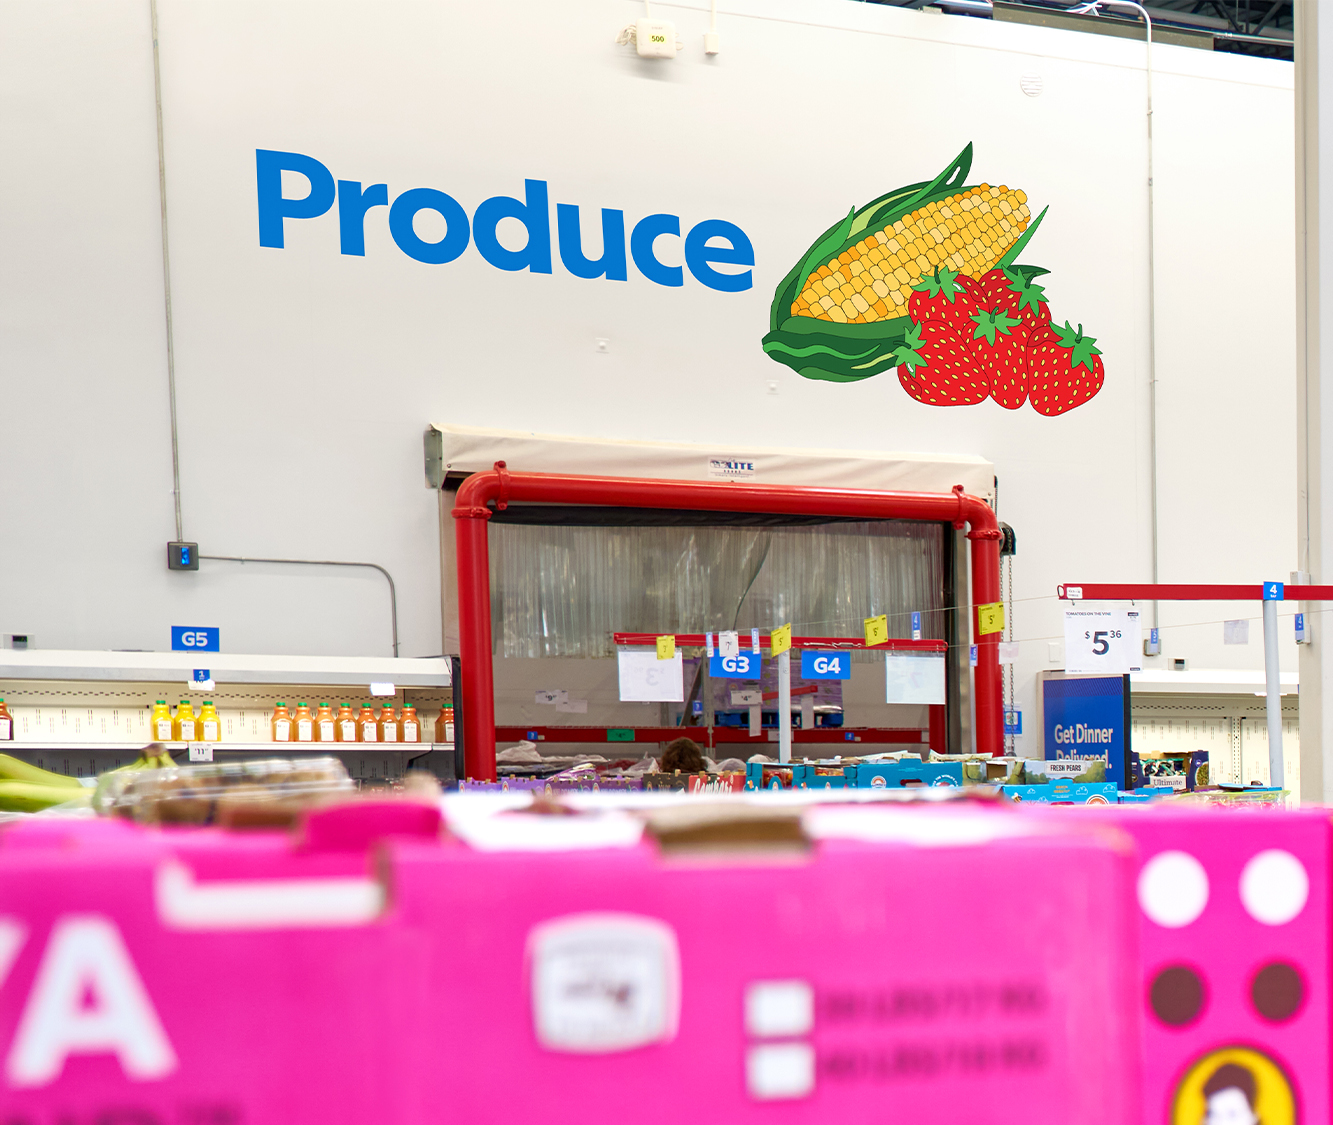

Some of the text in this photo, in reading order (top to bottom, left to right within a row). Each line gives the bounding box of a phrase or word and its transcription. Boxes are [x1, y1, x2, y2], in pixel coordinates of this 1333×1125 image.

[255, 148, 755, 293] Produce
[1269, 584, 1278, 594] 4
[182, 631, 208, 647] G5
[722, 656, 750, 673] G3
[813, 657, 841, 674] G4
[1055, 723, 1113, 744] Get Dinner
[1050, 764, 1081, 772] FRESH PEARS
[1153, 778, 1182, 787] Ultimate
